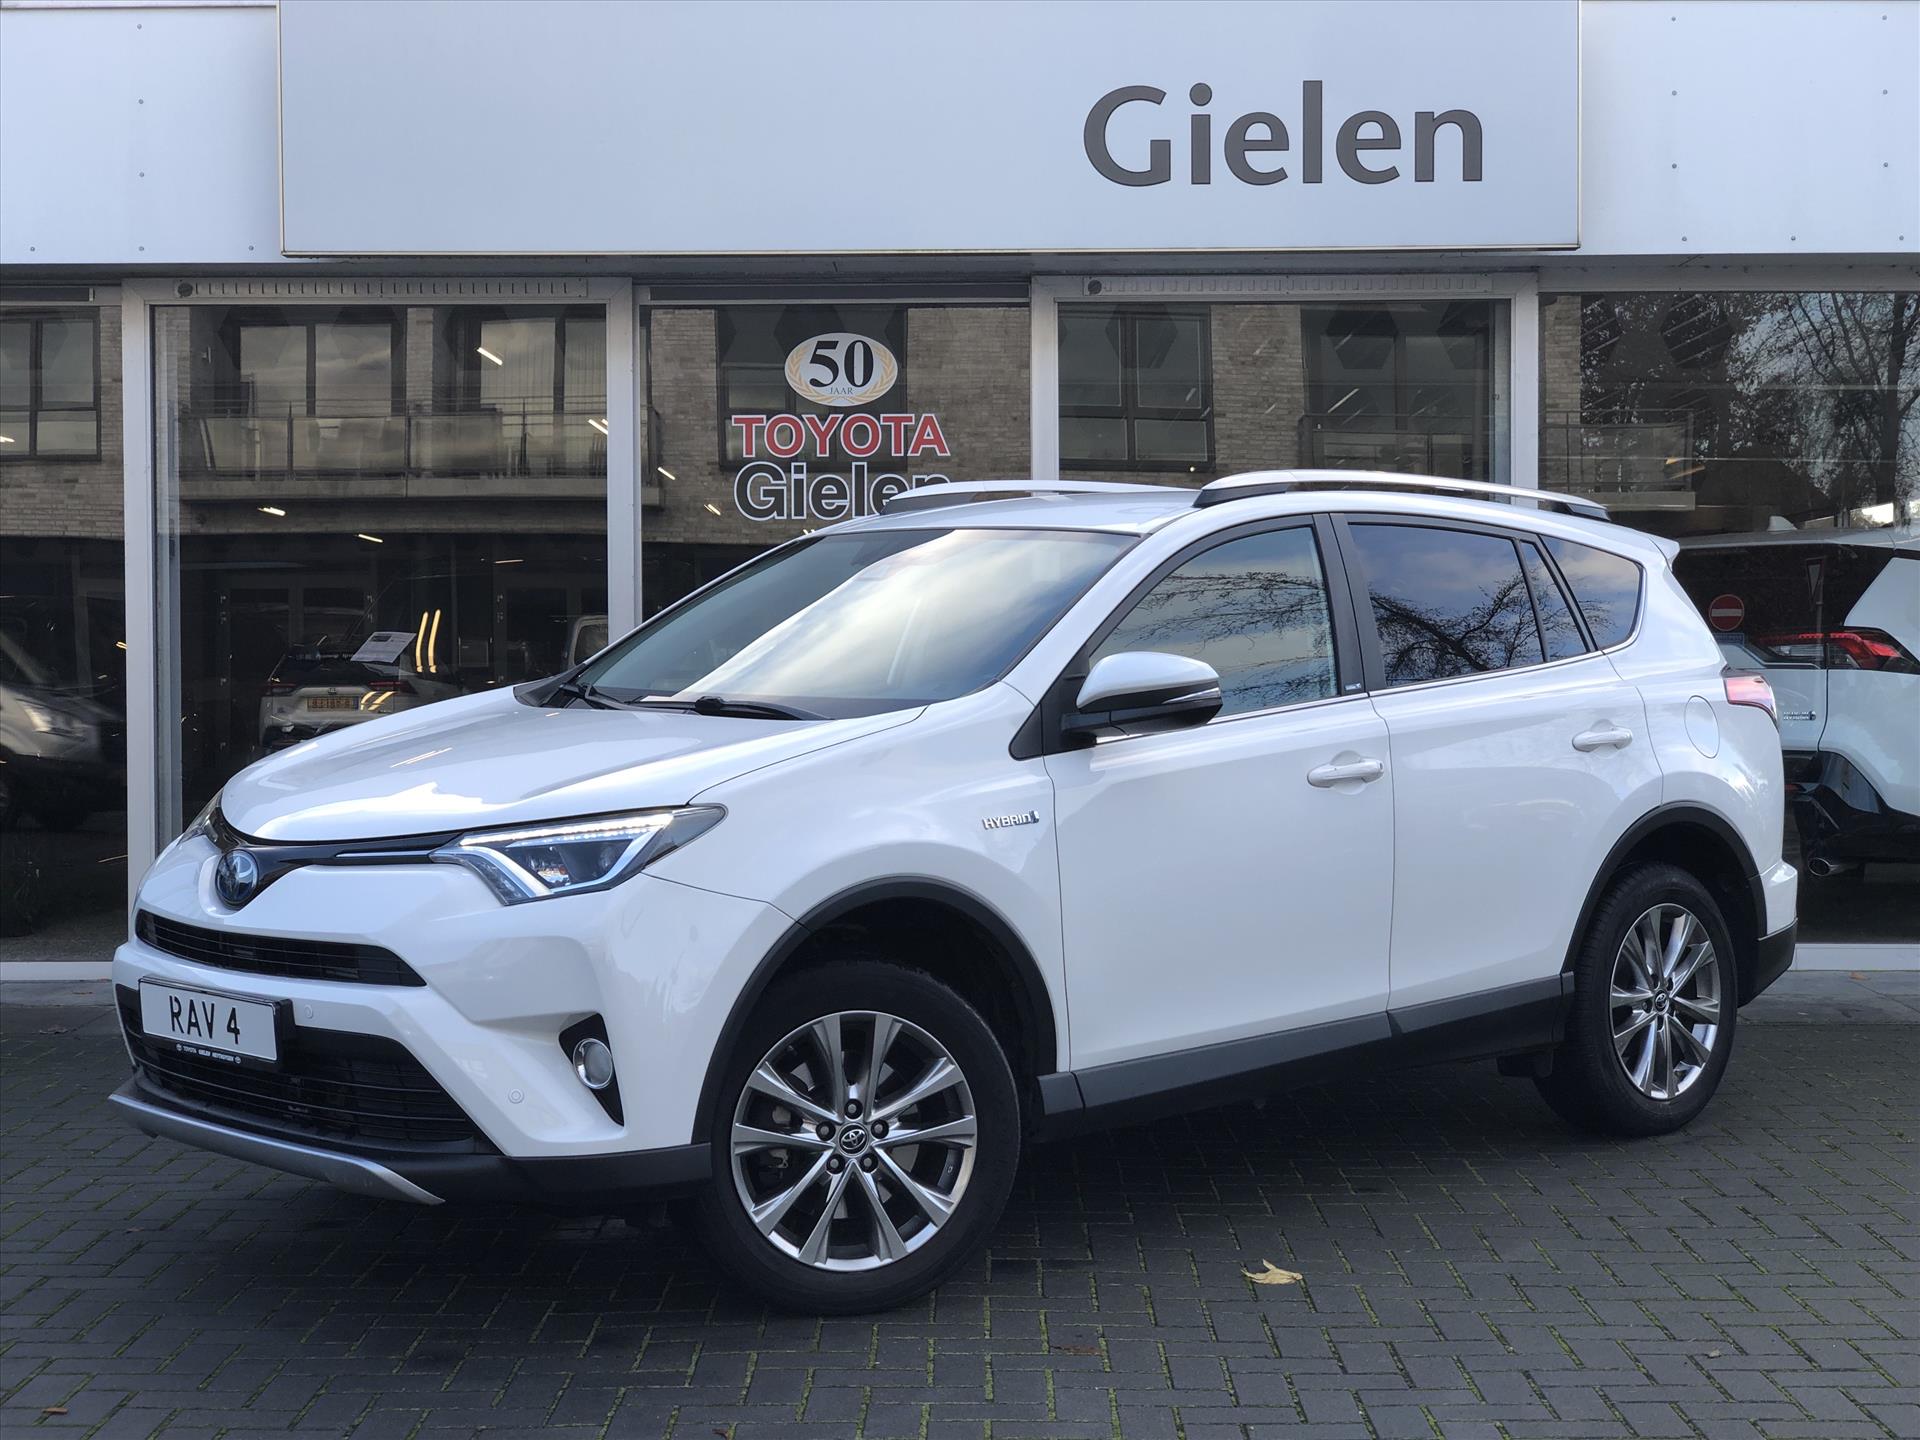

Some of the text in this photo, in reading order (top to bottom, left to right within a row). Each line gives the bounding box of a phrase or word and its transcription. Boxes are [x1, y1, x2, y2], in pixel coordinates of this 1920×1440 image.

[1084, 80, 1483, 187] Gielen
[809, 340, 874, 387] 50
[829, 387, 853, 395] JAAR
[732, 413, 950, 458] TOYOTA
[734, 461, 950, 521] Giele
[982, 813, 1031, 830] HYBRID
[169, 995, 241, 1045] RAV 4
